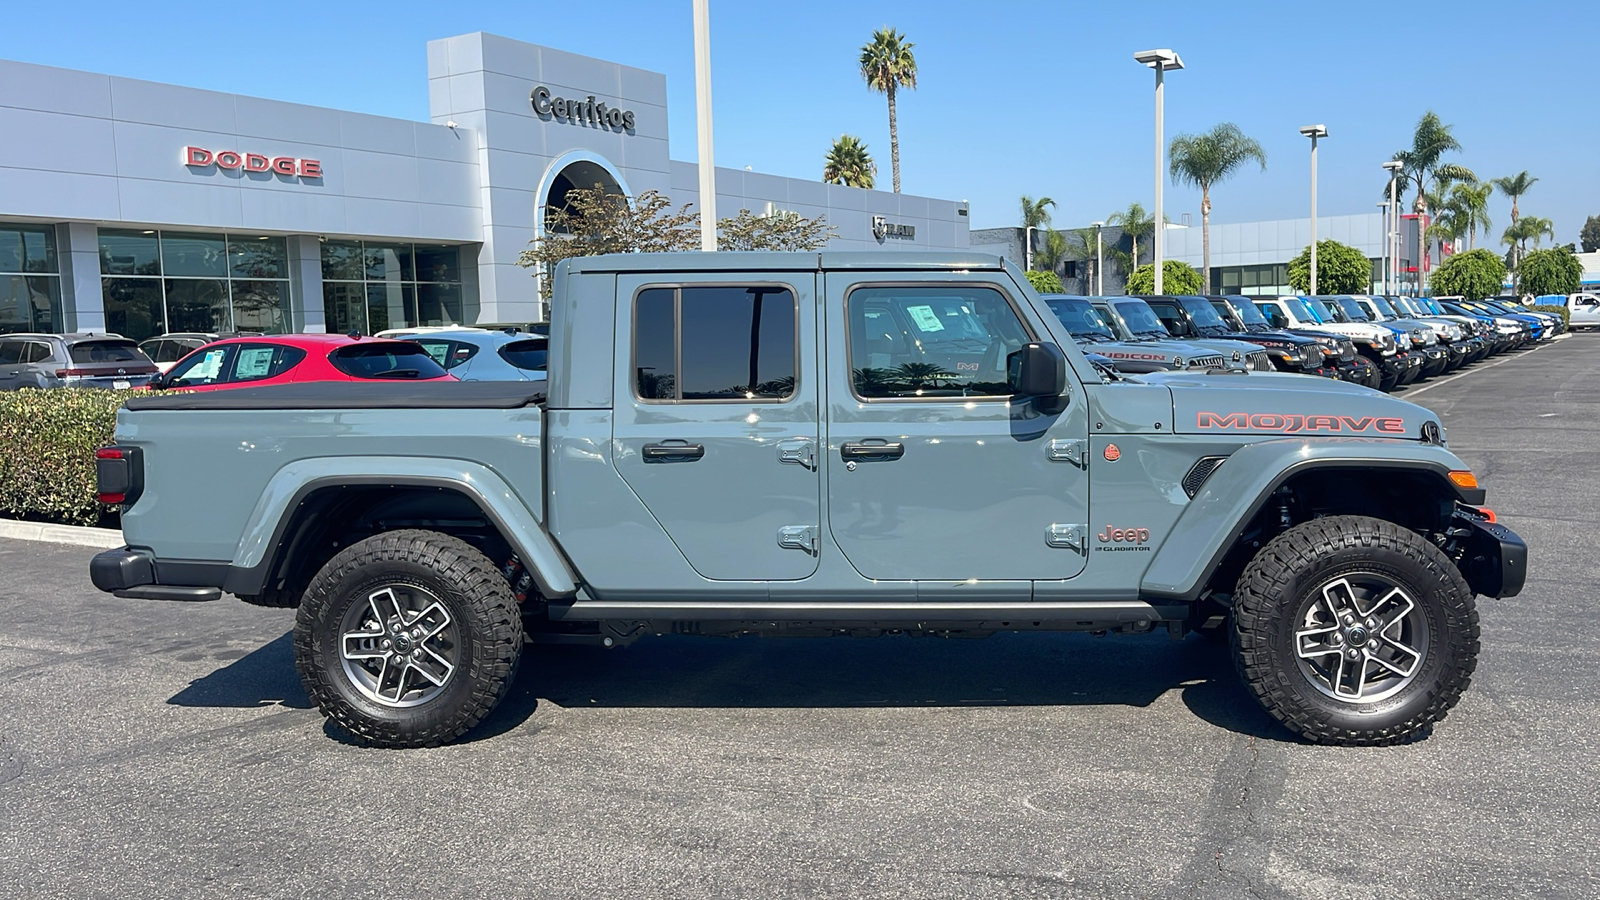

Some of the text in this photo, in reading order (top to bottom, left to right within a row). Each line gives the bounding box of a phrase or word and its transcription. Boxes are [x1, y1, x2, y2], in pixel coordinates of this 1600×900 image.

[531, 86, 635, 130] Cerritos
[184, 146, 323, 178] DODGE
[886, 224, 915, 236] RAM
[1197, 412, 1405, 433] MOJAVE
[1098, 525, 1149, 545] Jeep
